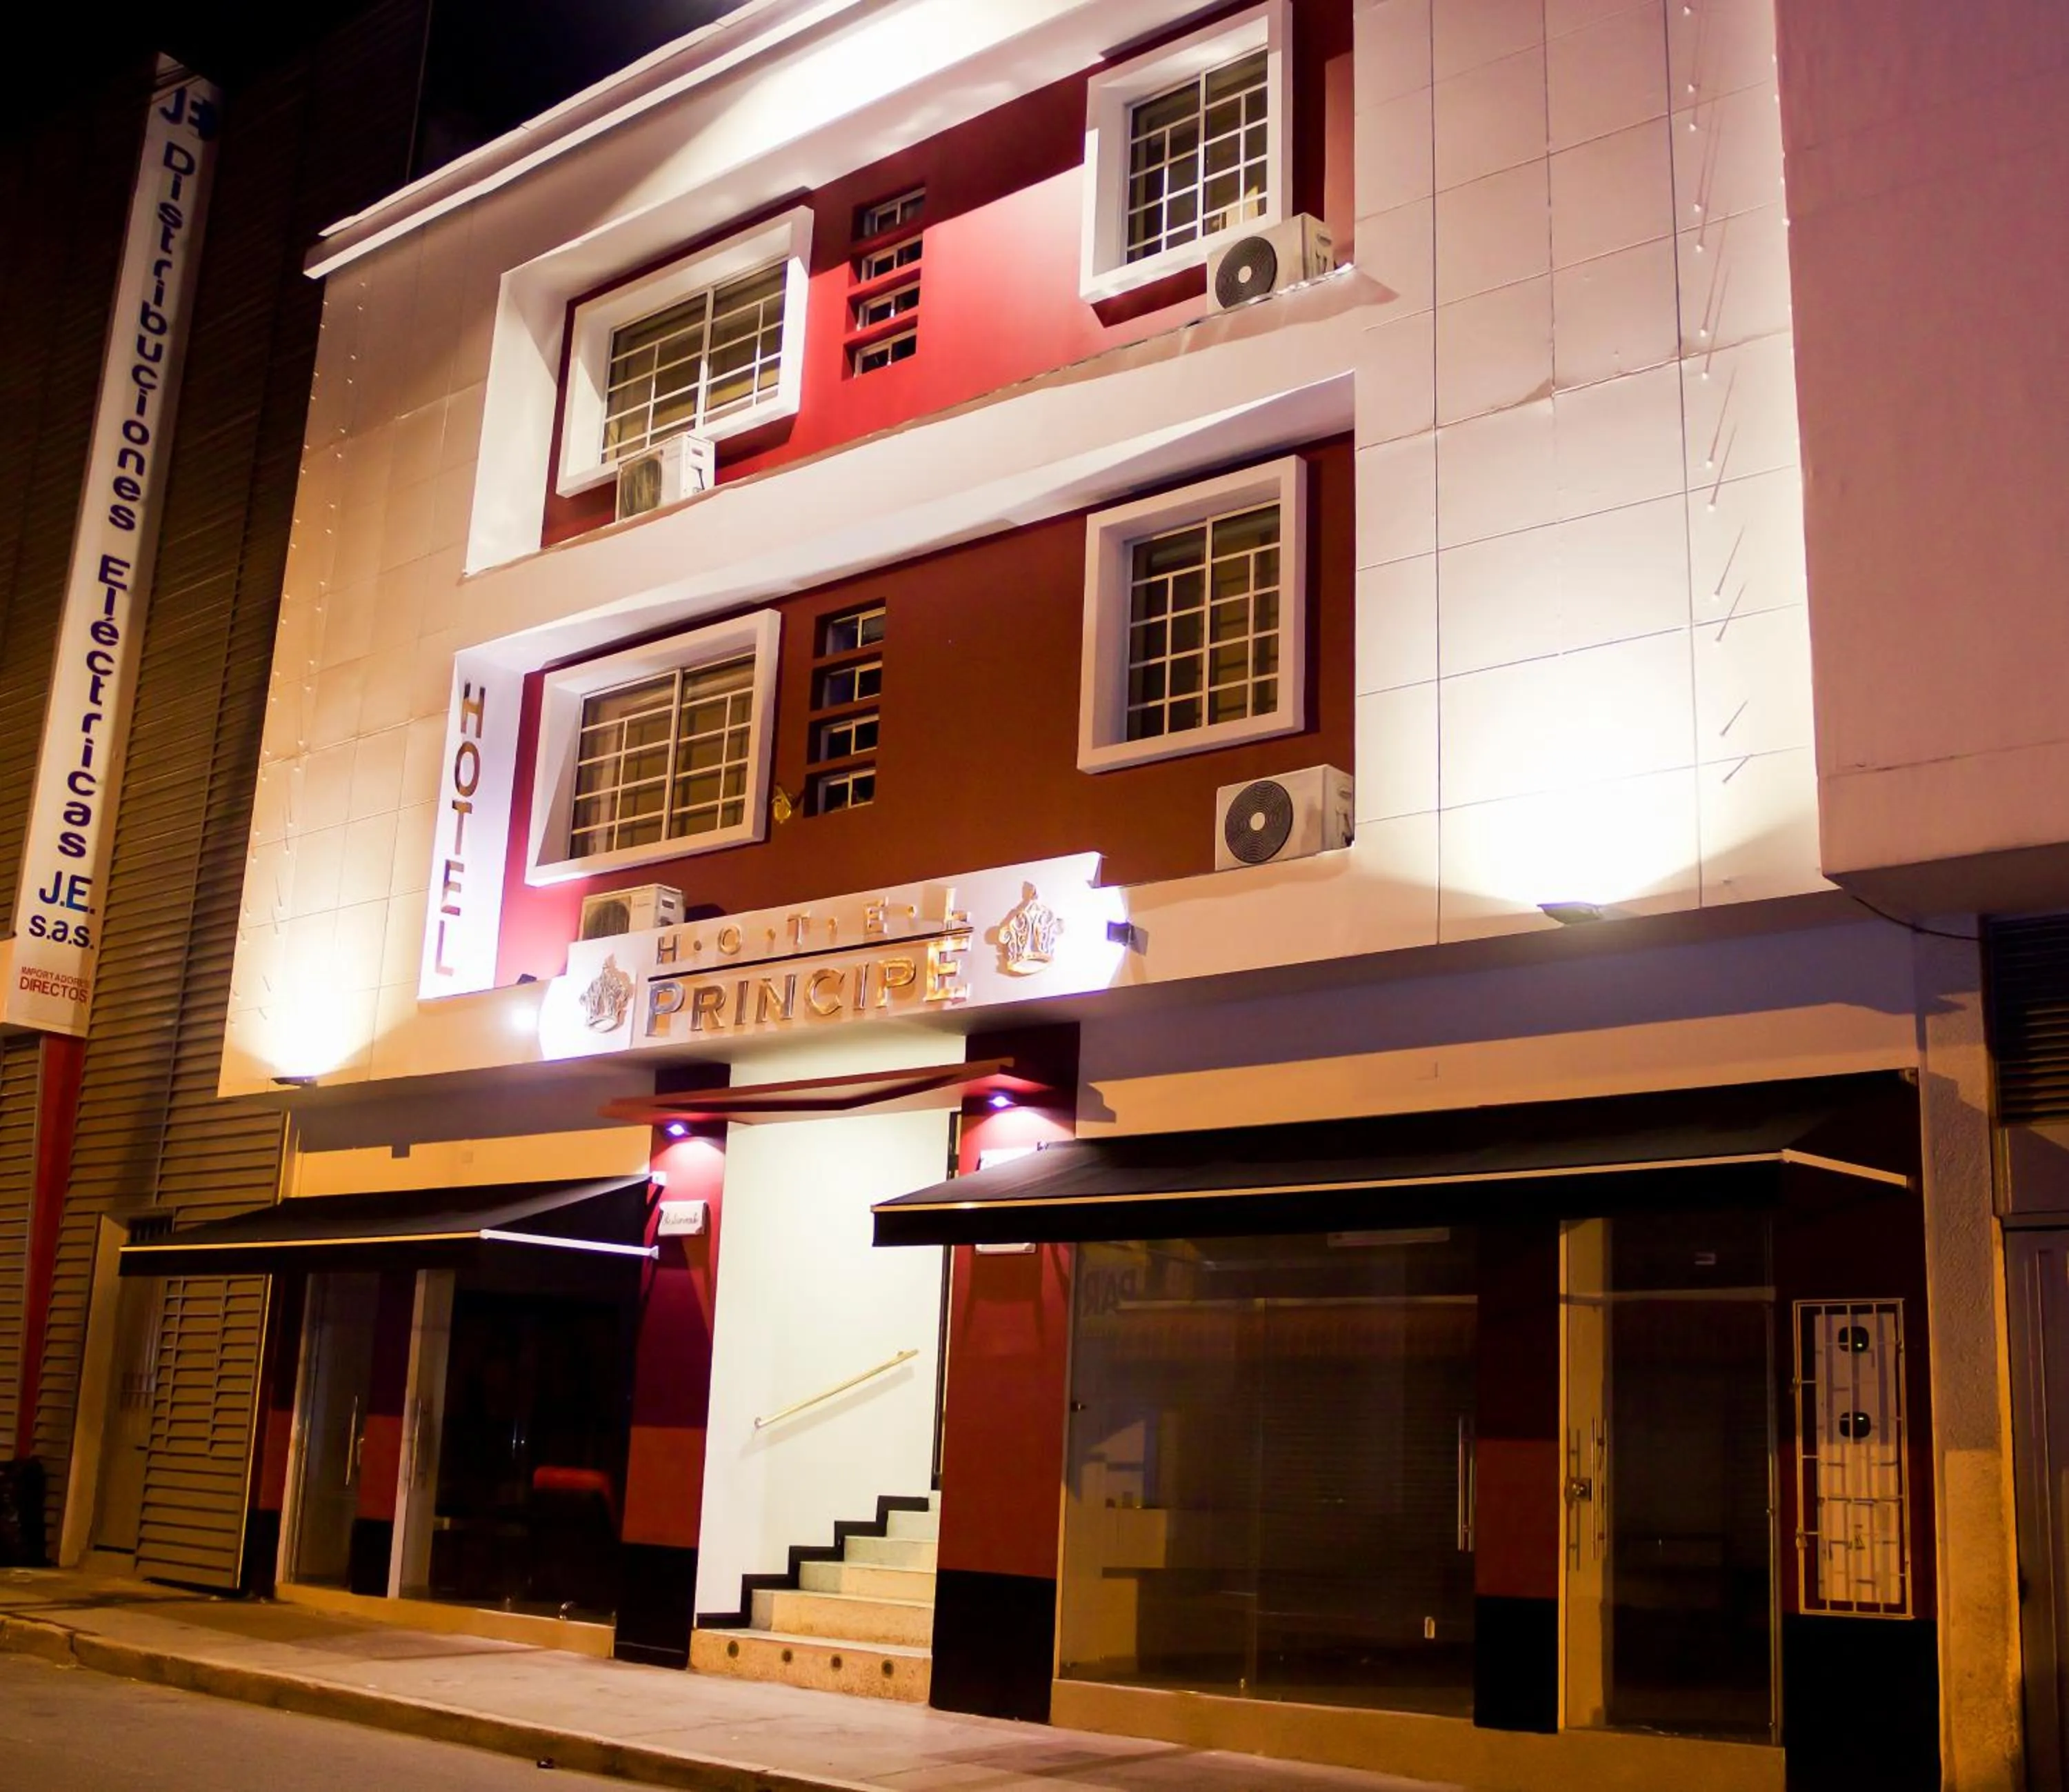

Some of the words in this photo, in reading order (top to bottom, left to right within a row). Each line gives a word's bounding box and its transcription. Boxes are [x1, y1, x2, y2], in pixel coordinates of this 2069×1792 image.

[108, 141, 196, 531] Distribuciones
[435, 681, 486, 977] HOTEL
[39, 870, 95, 915] J.E.
[28, 914, 94, 950] s.a.s.
[19, 976, 90, 1003] DIRECTOS
[21, 966, 90, 989] IMPORTADORES
[646, 934, 972, 1037] PRINCIPE
